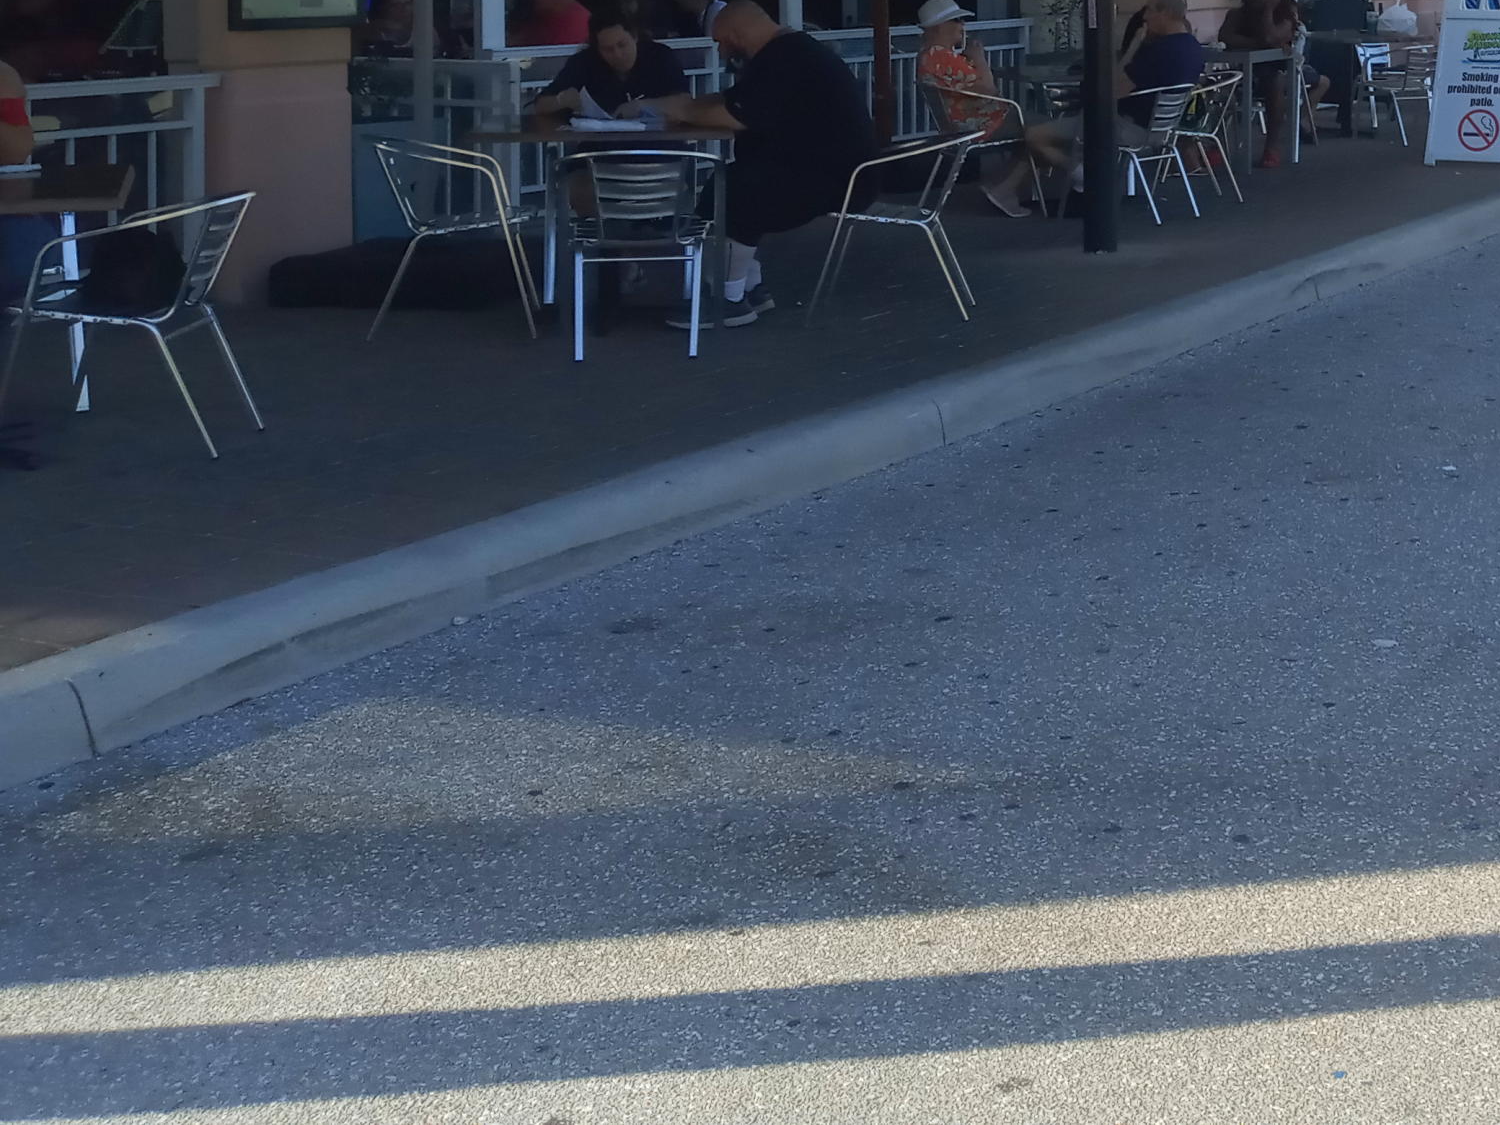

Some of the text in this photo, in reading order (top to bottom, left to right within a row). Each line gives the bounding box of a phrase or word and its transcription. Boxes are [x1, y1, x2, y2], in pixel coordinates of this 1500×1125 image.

[1462, 72, 1499, 83] Smoking
[1447, 84, 1492, 94] prohibited
[1470, 97, 1494, 107] patio.
